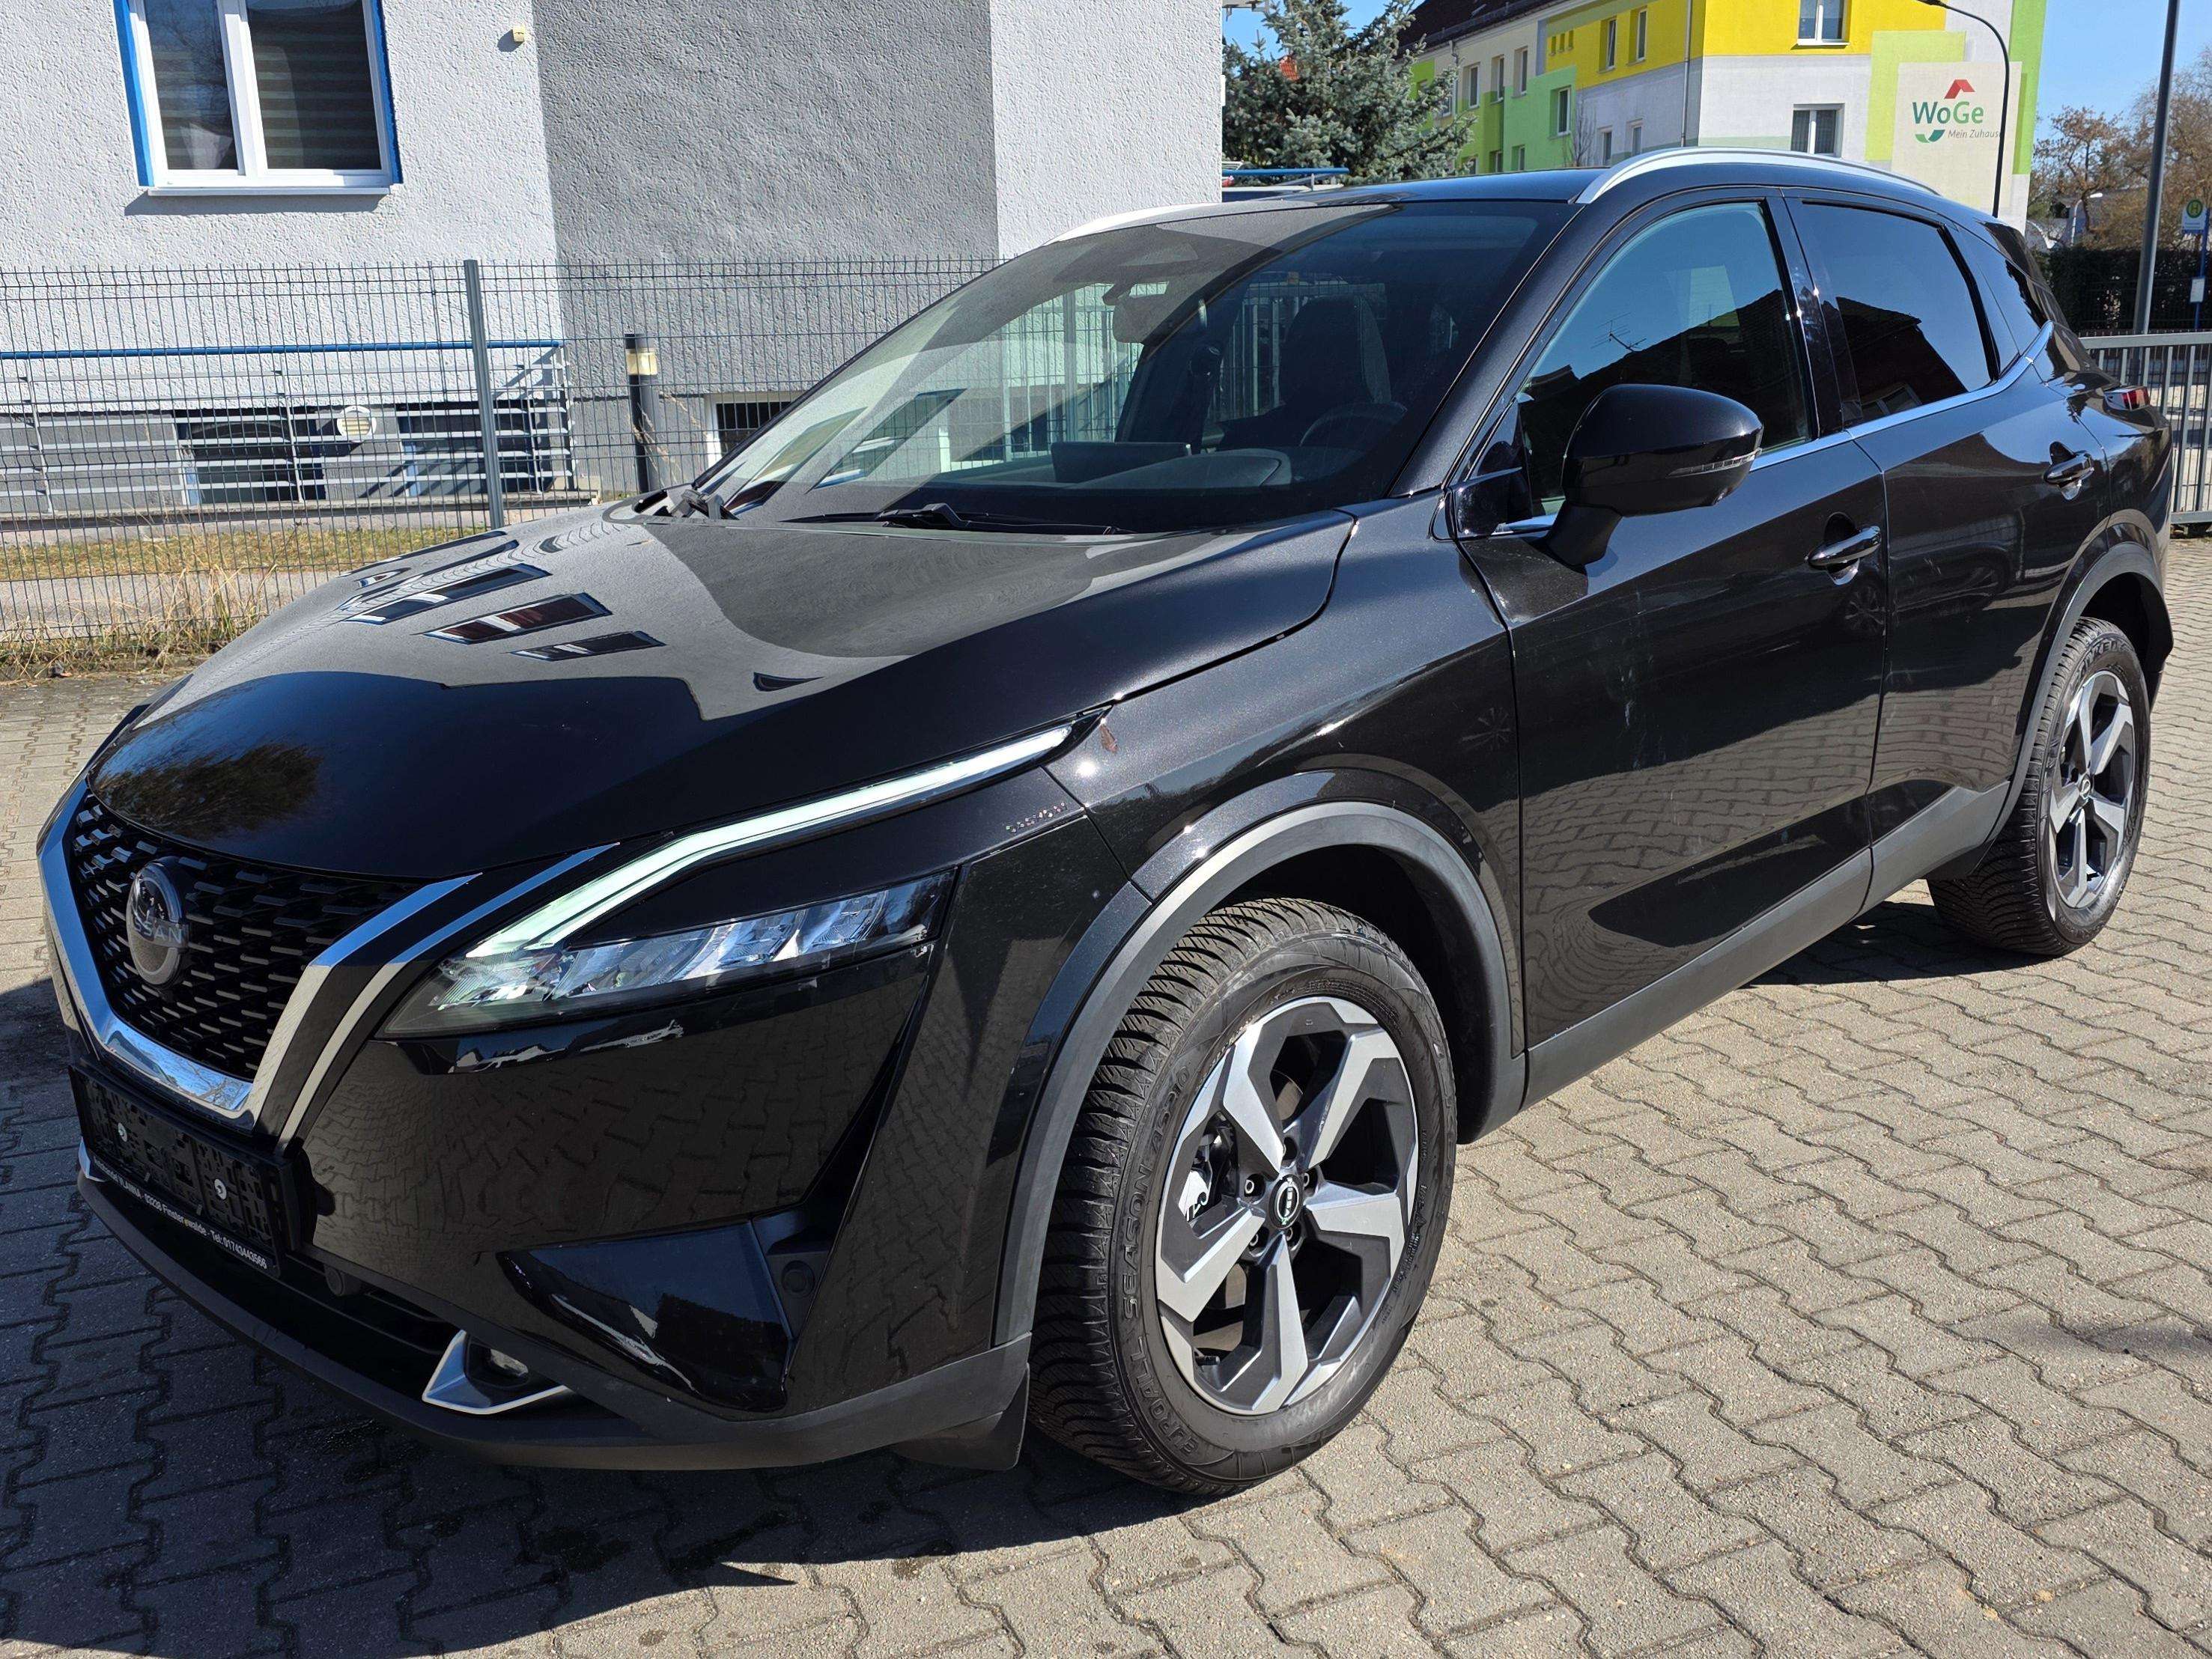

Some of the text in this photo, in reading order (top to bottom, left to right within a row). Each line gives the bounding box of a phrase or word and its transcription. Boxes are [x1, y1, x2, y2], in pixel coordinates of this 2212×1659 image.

[1912, 101, 1984, 124] WoGe
[1948, 129, 2002, 138] Mein Zuhaus
[133, 916, 182, 944] SSAN
[1123, 1163, 1154, 1319] SEASON
[1130, 1336, 1199, 1454] EUROALL
